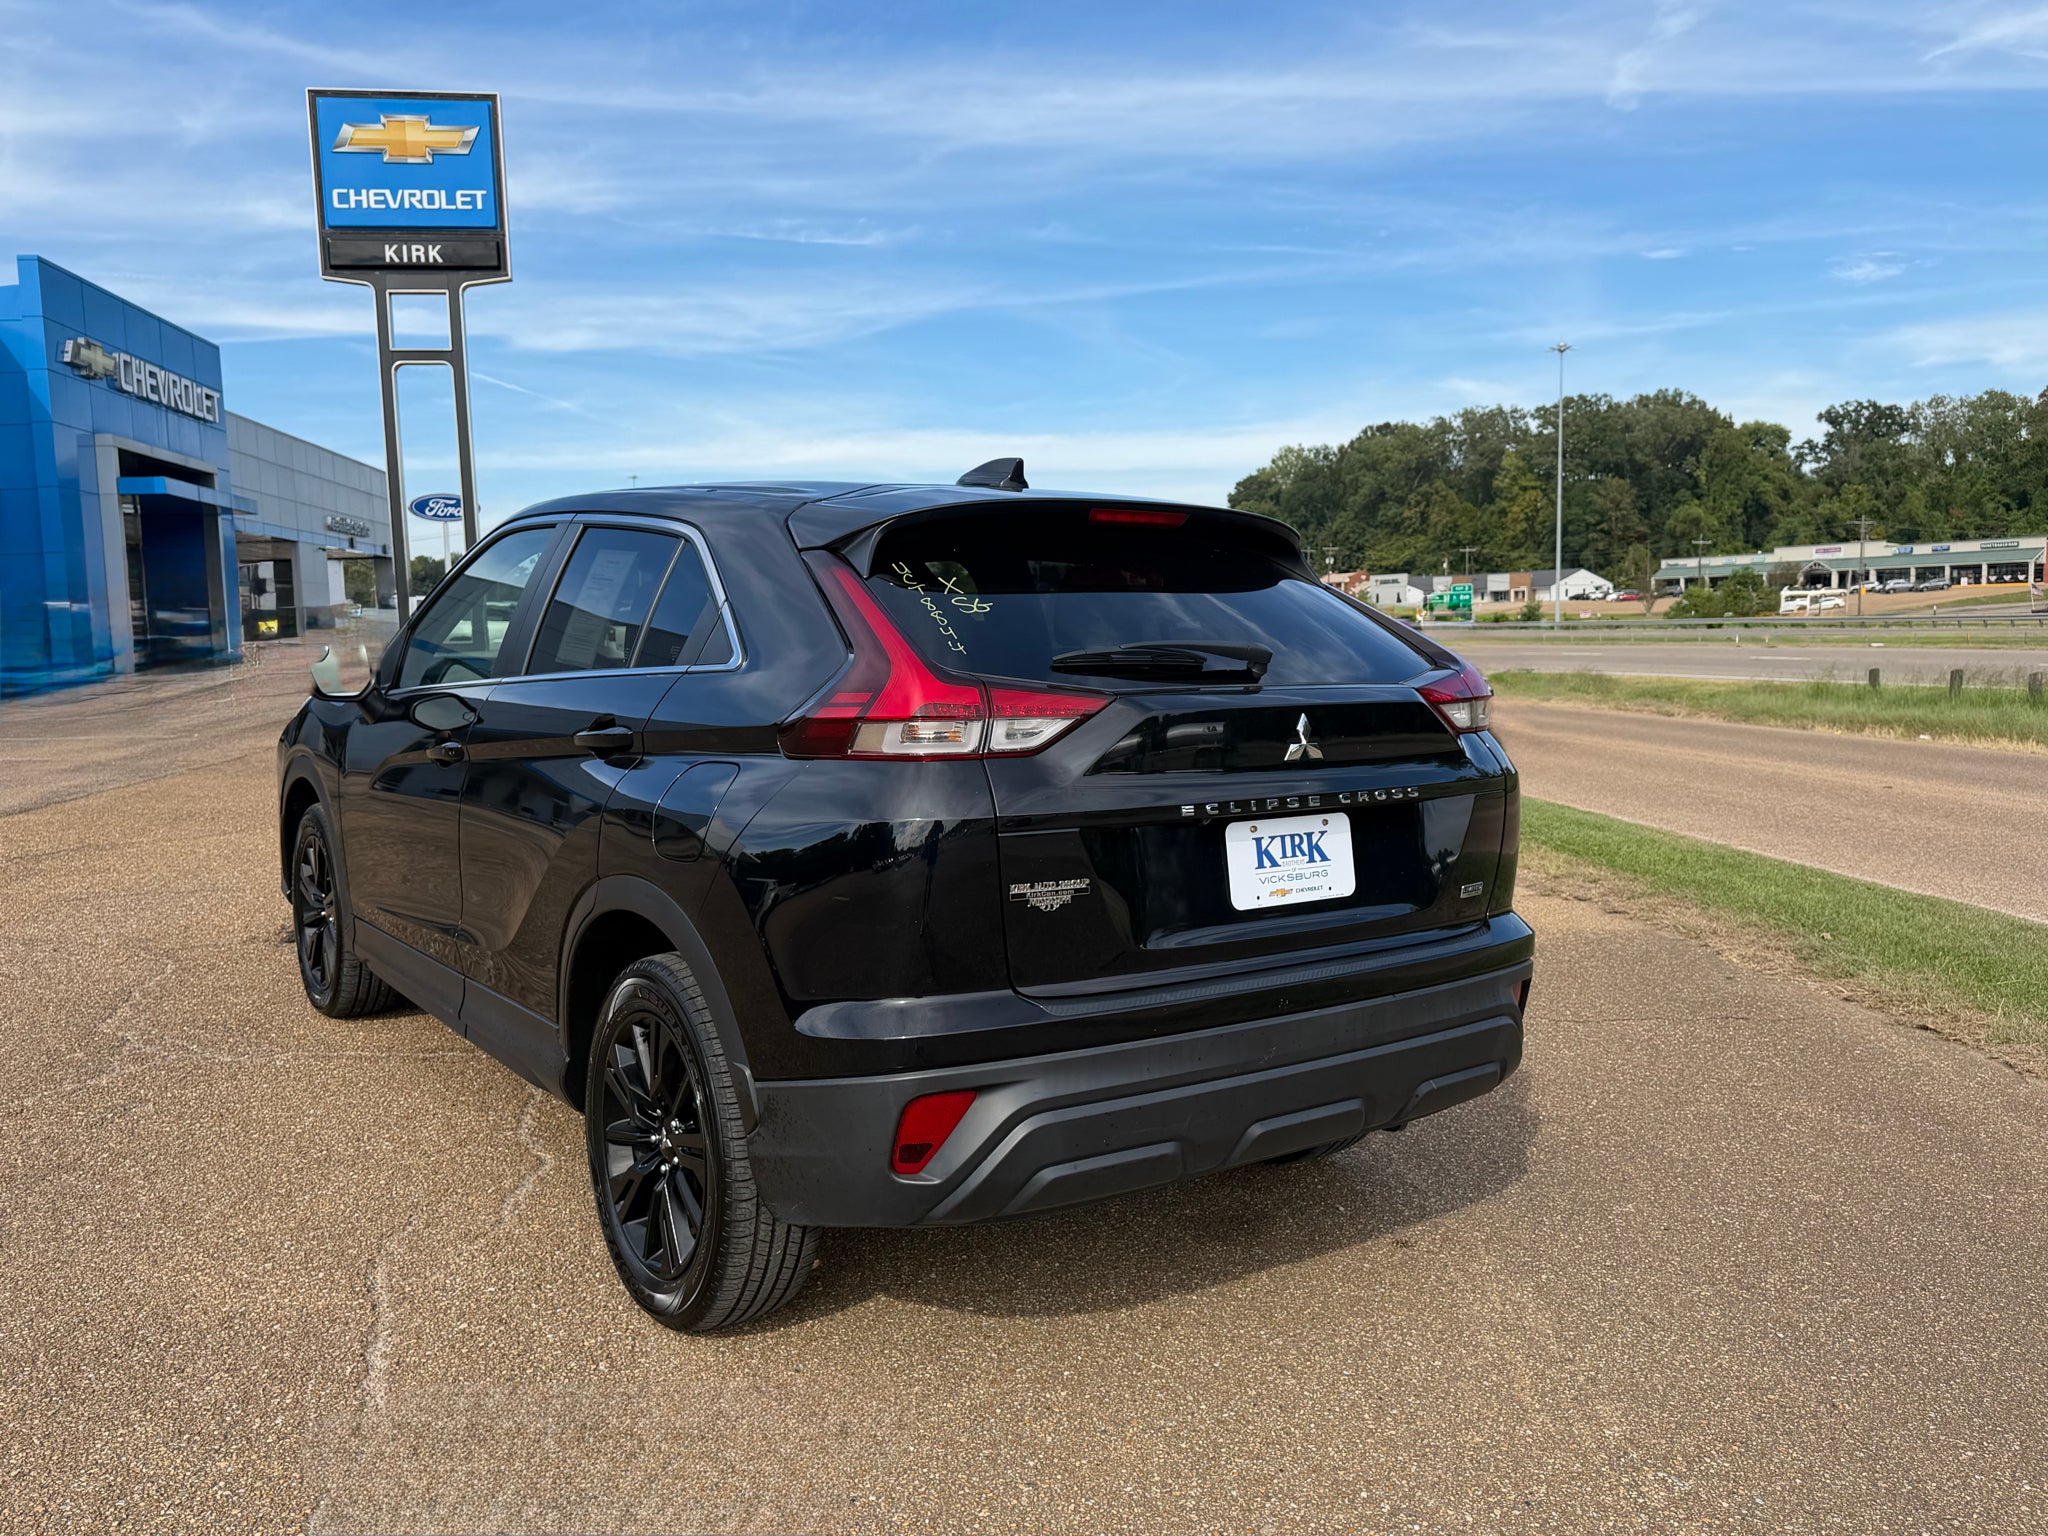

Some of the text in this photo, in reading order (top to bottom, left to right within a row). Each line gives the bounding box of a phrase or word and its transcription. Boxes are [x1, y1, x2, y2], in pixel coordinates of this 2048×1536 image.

[332, 188, 487, 210] CHEVROLET
[384, 244, 444, 263] KIRK
[114, 352, 220, 424] CHEVROLET
[1181, 786, 1420, 816] ECLIPSE CROSS
[1251, 830, 1332, 870] KIRK
[1258, 869, 1329, 885] VICKSBURG
[1009, 883, 1031, 893] KIRK
[1295, 885, 1324, 893] CHEVROLET
